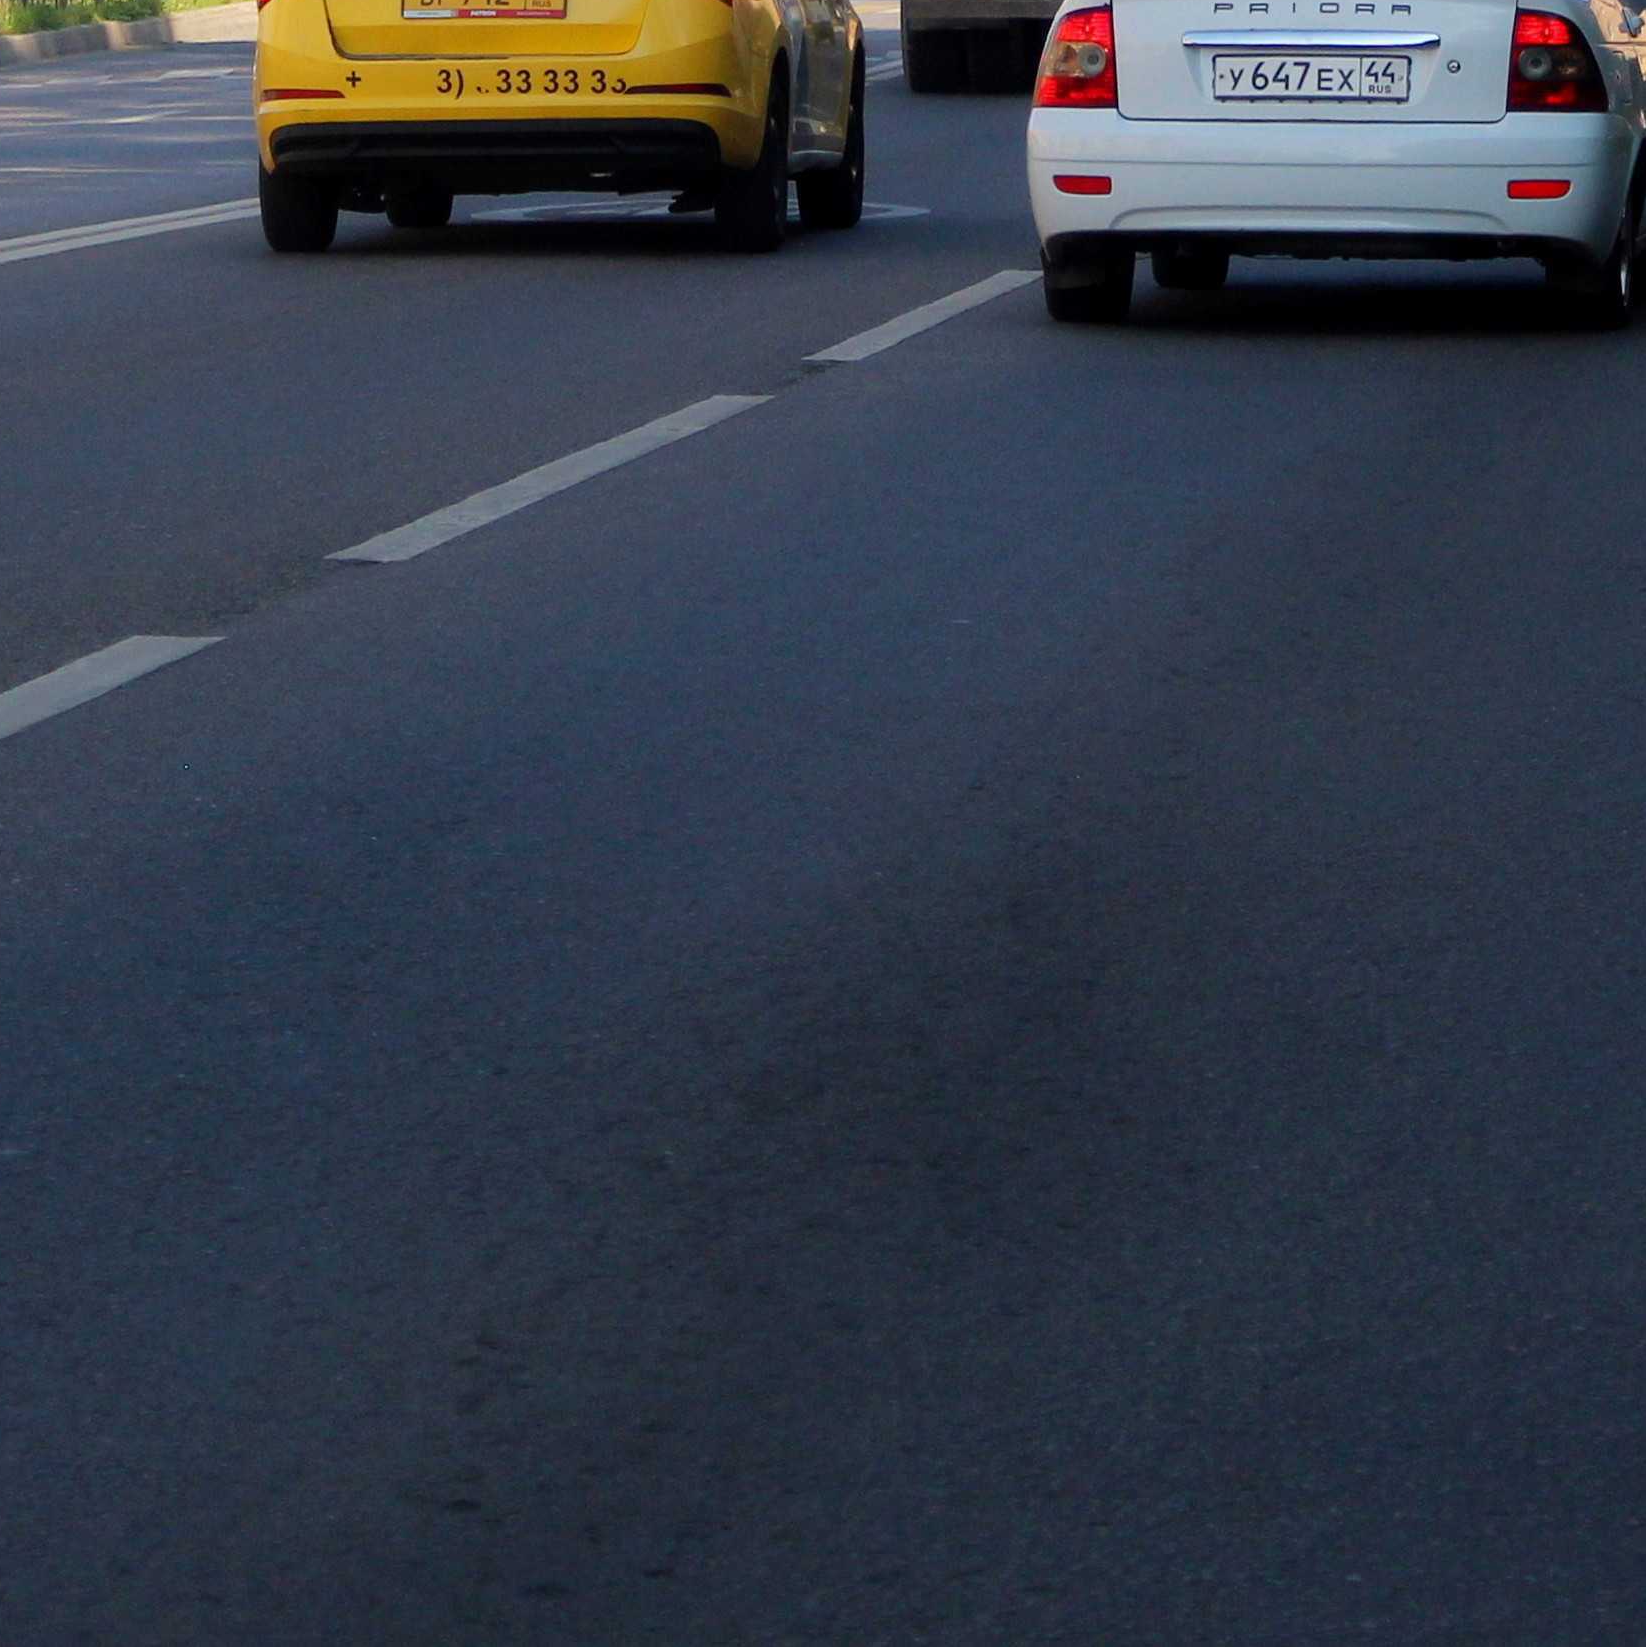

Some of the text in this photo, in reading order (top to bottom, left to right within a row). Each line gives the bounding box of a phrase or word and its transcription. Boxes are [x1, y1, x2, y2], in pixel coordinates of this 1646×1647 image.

[1213, 2, 1412, 15] PRIORA
[1364, 61, 1396, 84] 44
[542, 69, 580, 95] 33
[1368, 84, 1392, 94] RUS
